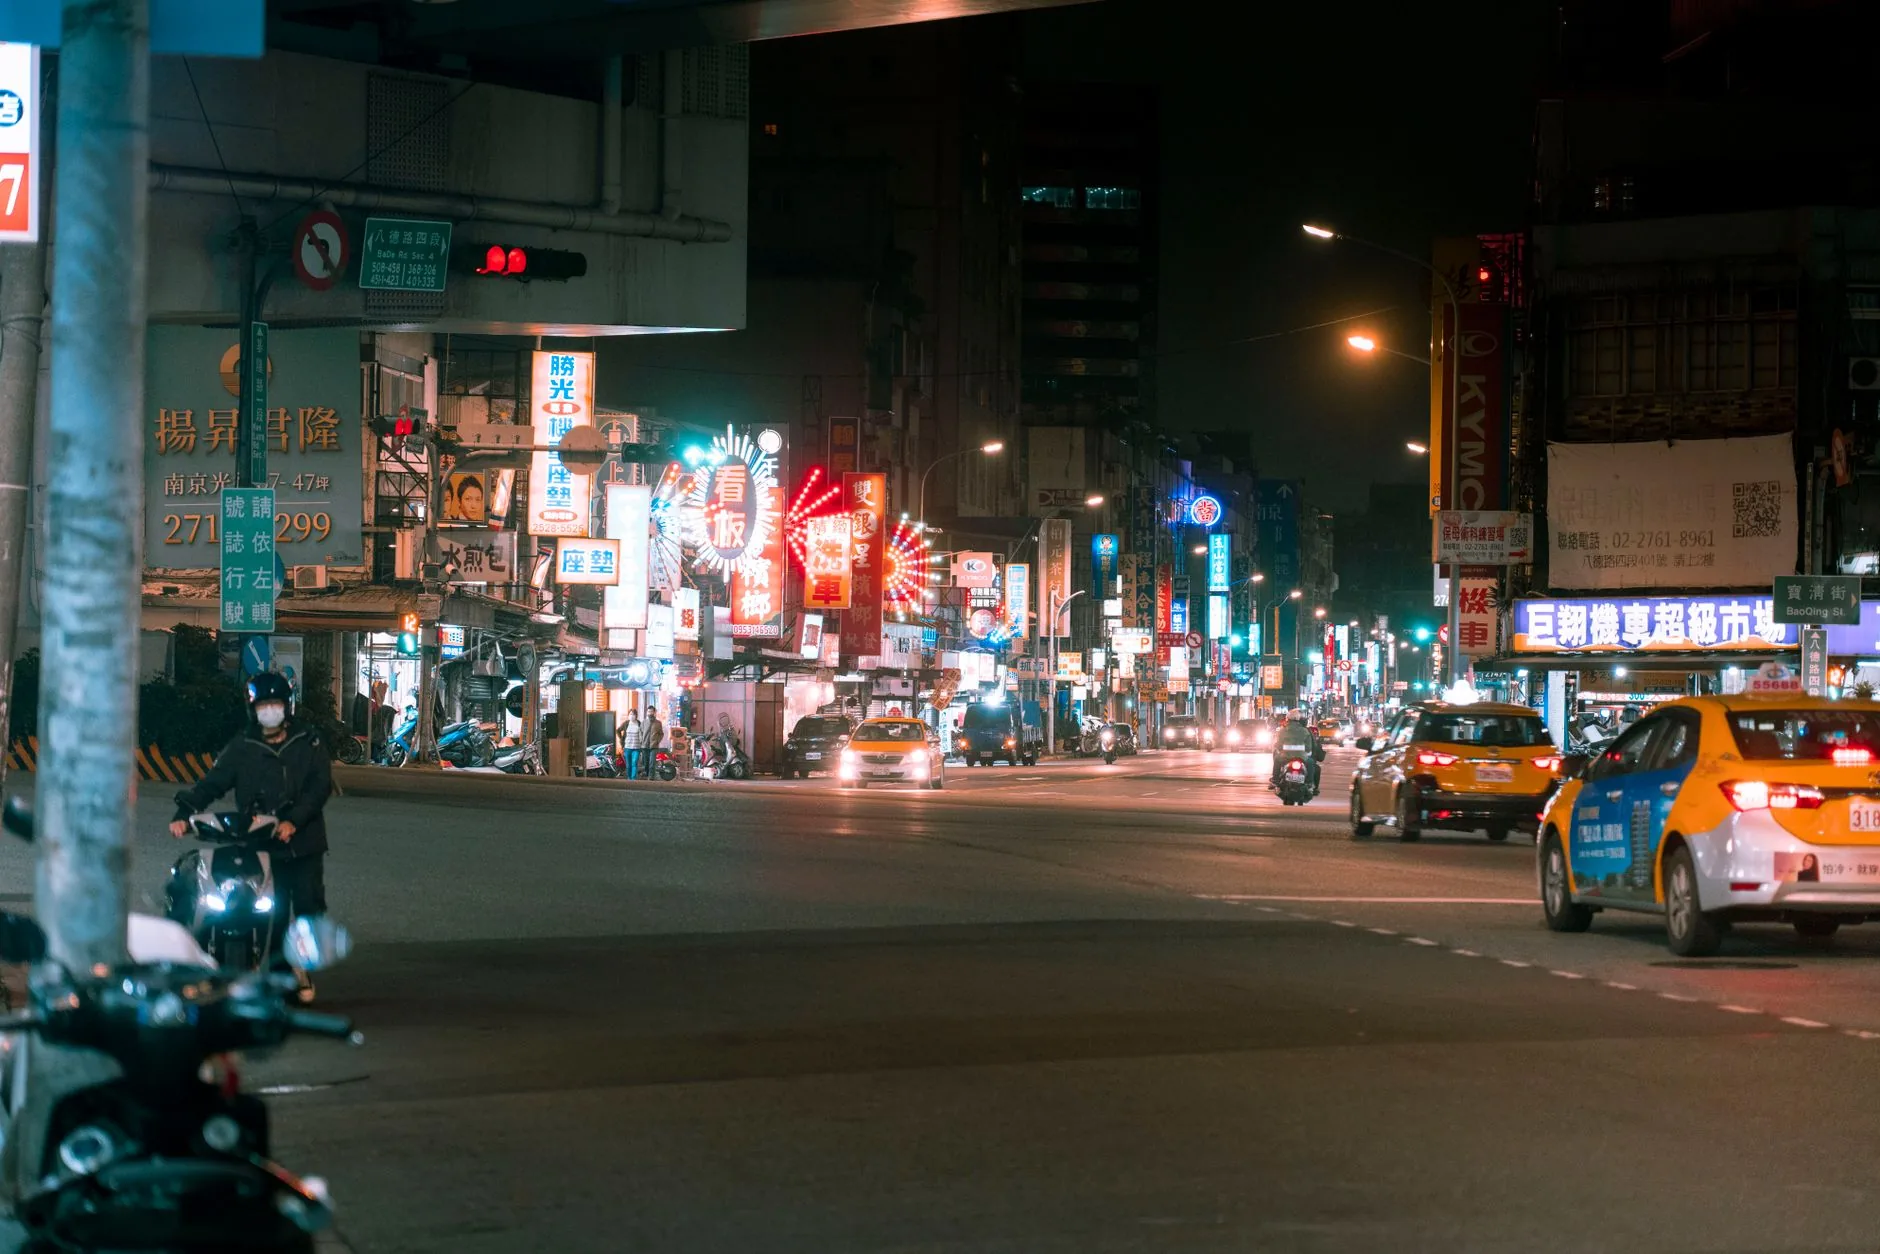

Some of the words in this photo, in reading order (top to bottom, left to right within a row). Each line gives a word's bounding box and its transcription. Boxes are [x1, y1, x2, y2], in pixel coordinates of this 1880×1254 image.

[374, 229, 441, 247] 八德路四段
[428, 252, 435, 261] 4
[549, 355, 575, 400] 勝光
[164, 472, 240, 496] 南京光
[713, 464, 746, 548] 看板
[1612, 530, 1715, 549] 02-2761-8961
[225, 496, 245, 624] 號誌行駛
[252, 496, 272, 624] 請依左轉
[440, 543, 506, 573] 水煎包
[562, 549, 614, 574] 座墊
[811, 538, 843, 605] 洗車
[1459, 587, 1489, 648] 機車
[1526, 601, 1786, 647] 巨翔機車超級市場
[1786, 606, 1828, 617] BaoQing
[1140, 637, 1150, 649] P
[1753, 680, 1799, 690] 55688
[1852, 810, 1880, 828] 318
